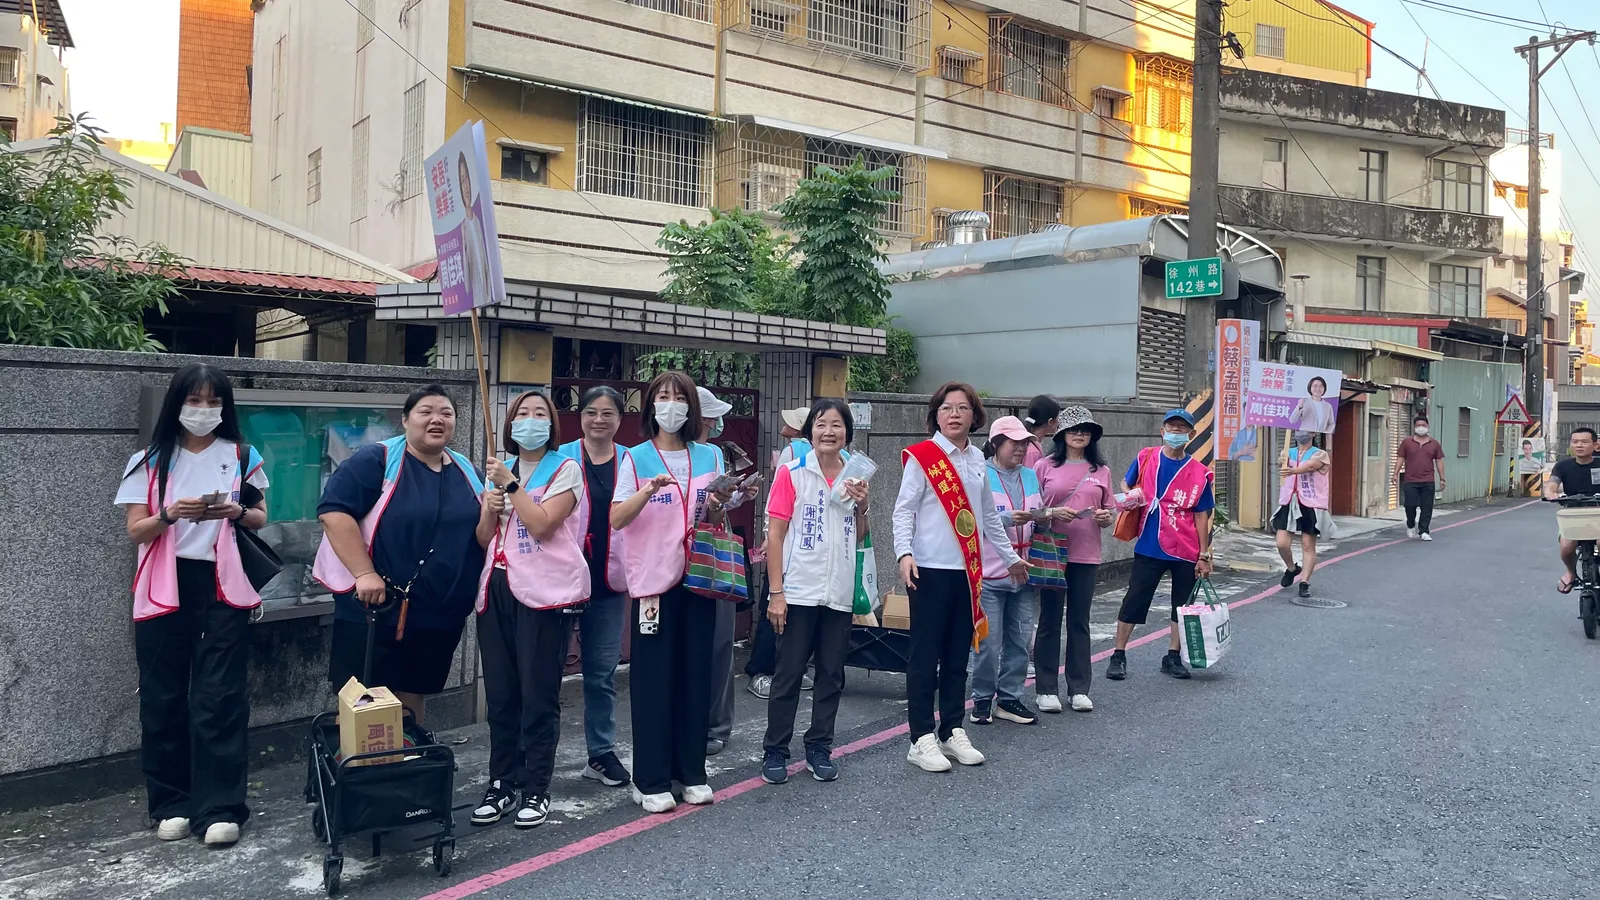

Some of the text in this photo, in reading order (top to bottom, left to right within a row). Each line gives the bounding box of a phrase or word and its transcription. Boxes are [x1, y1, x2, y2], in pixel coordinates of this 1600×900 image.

[1168, 263, 1219, 280] 徐州路
[1169, 280, 1206, 295] 142巷
[1262, 367, 1286, 379] 安居
[1285, 369, 1295, 392] 好生活
[1260, 378, 1285, 391] 樂業
[1249, 402, 1290, 418] 周佳琪
[1507, 408, 1521, 421] 慢
[927, 464, 960, 513] 候選人
[938, 459, 967, 508] 屏東市長
[816, 489, 825, 542] 屏東市民代表
[801, 505, 817, 550] 謝雪鳳
